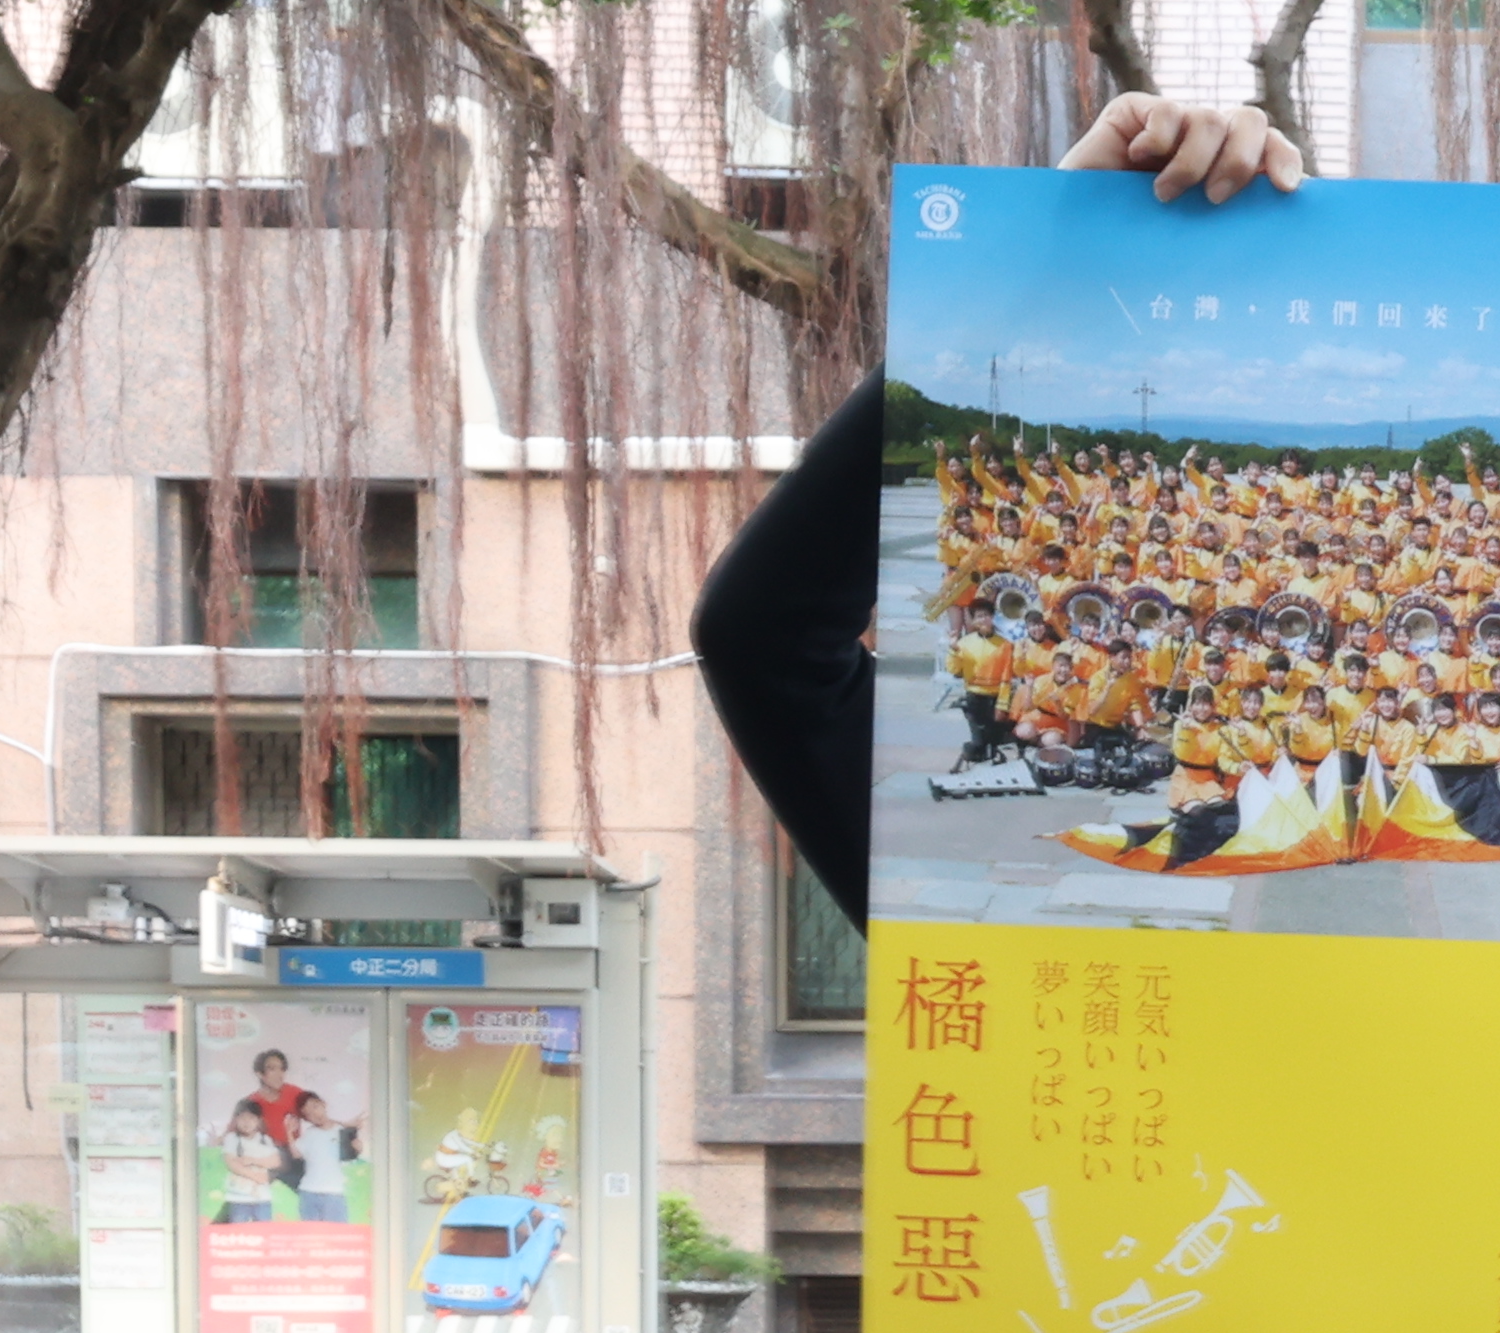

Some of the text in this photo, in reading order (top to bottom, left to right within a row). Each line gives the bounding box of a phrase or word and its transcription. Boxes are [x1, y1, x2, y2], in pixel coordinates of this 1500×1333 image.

[351, 958, 438, 975] 中正二分局
[1029, 960, 1069, 1142] 夢いっぱい
[1081, 961, 1120, 1181] 笑顔いっぱい
[1133, 964, 1172, 1182] 元気いっぱい
